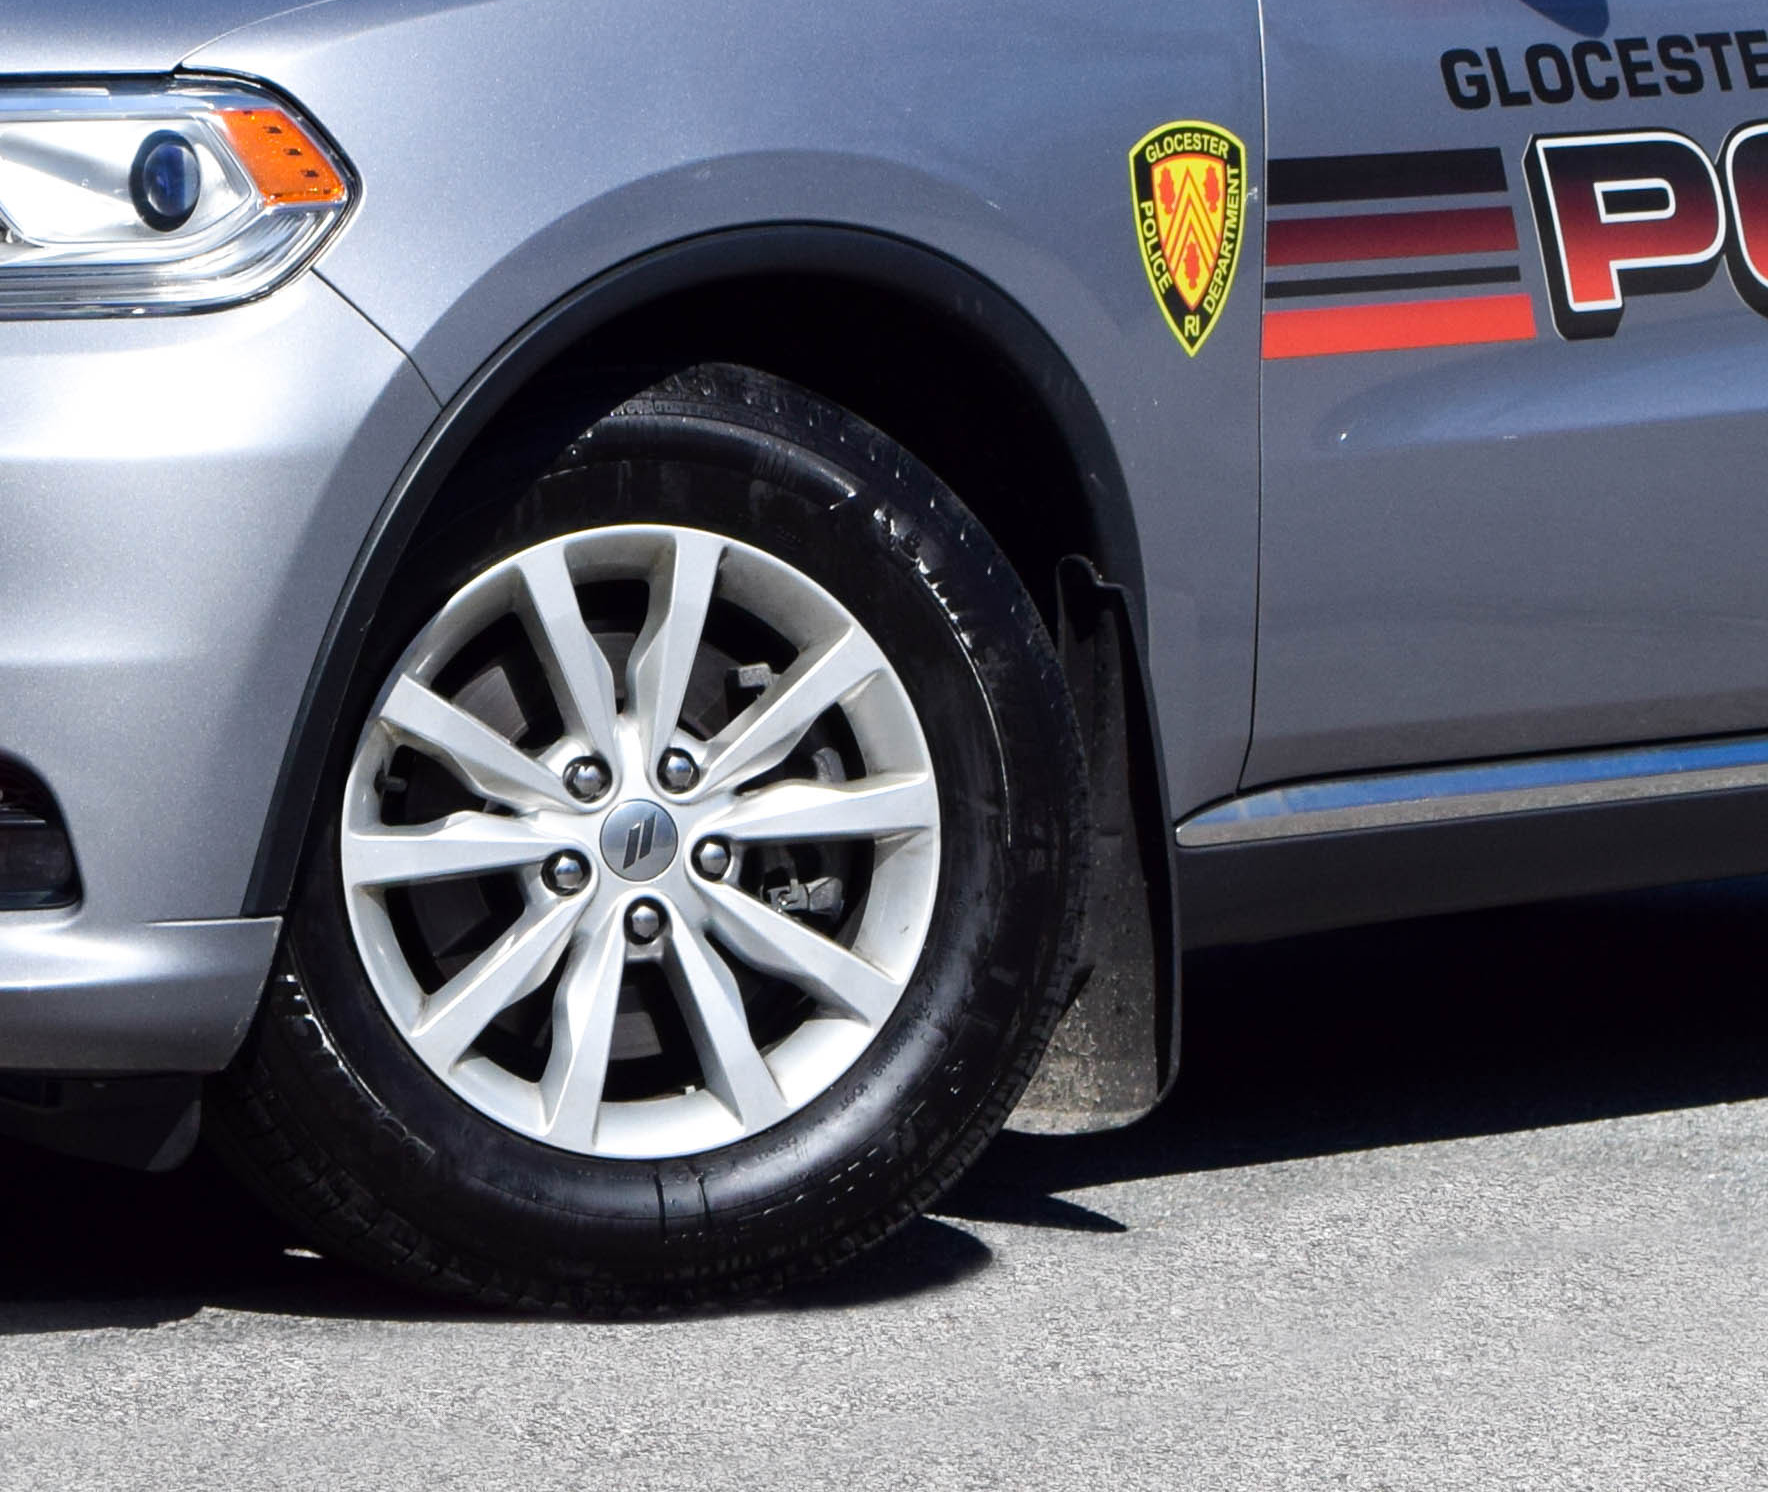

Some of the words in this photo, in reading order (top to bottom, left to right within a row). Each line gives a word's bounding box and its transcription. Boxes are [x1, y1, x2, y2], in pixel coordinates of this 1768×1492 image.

[1145, 132, 1230, 164] GLOCESTER
[1140, 200, 1174, 295] POLICE
[1202, 163, 1241, 315] DEPARTMENT
[1184, 314, 1201, 338] RI
